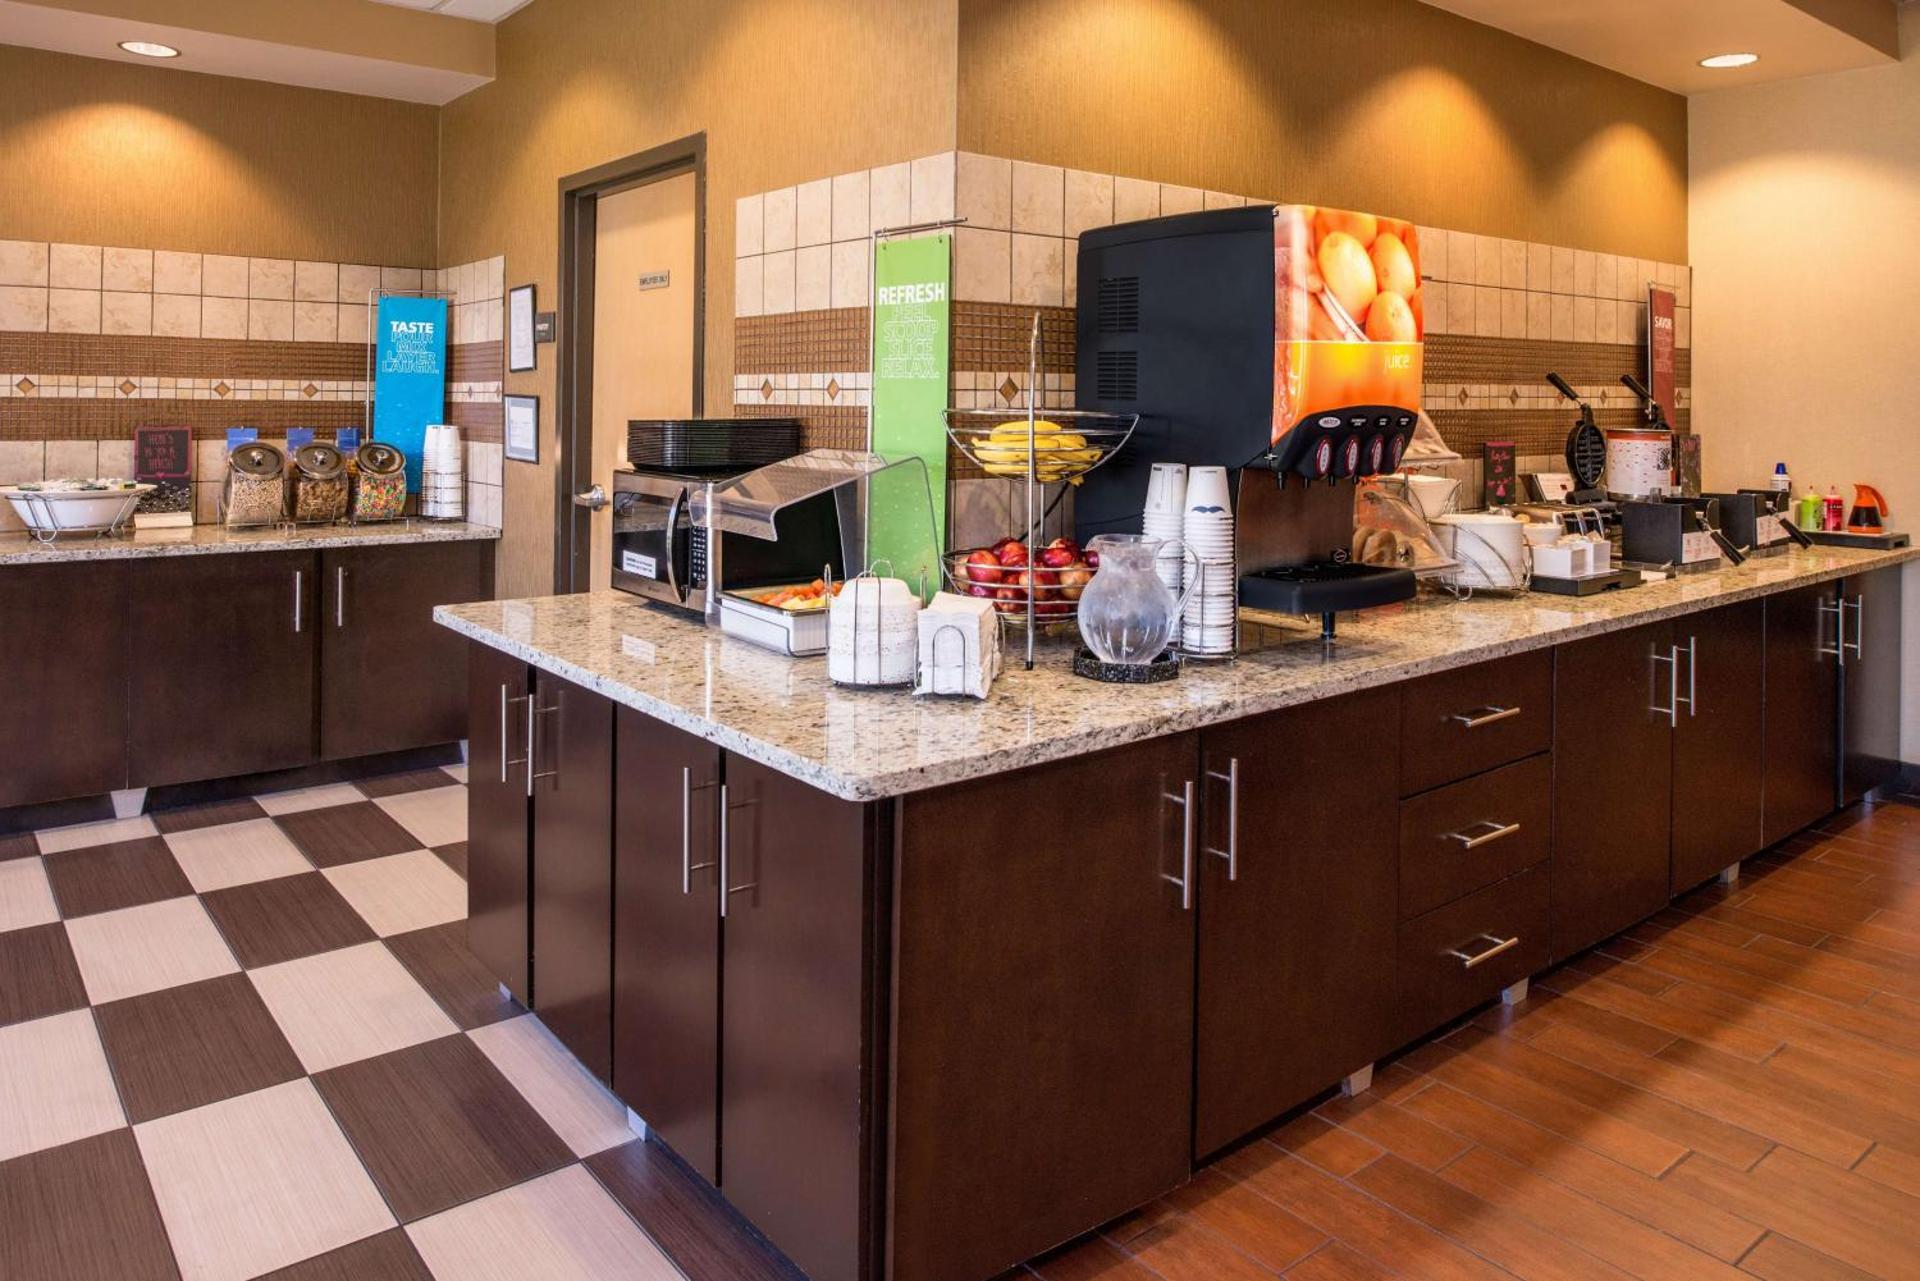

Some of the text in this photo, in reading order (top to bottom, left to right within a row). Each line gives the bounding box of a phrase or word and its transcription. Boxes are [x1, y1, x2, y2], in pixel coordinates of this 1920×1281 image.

[878, 282, 945, 305] REFRESH
[390, 321, 434, 334] TASTE
[883, 320, 938, 342] SCOOP
[391, 332, 433, 344] POUR
[396, 342, 427, 352] MIX
[888, 340, 933, 359] SLICE
[386, 351, 436, 363] LAYER
[880, 358, 940, 378] RELAX.
